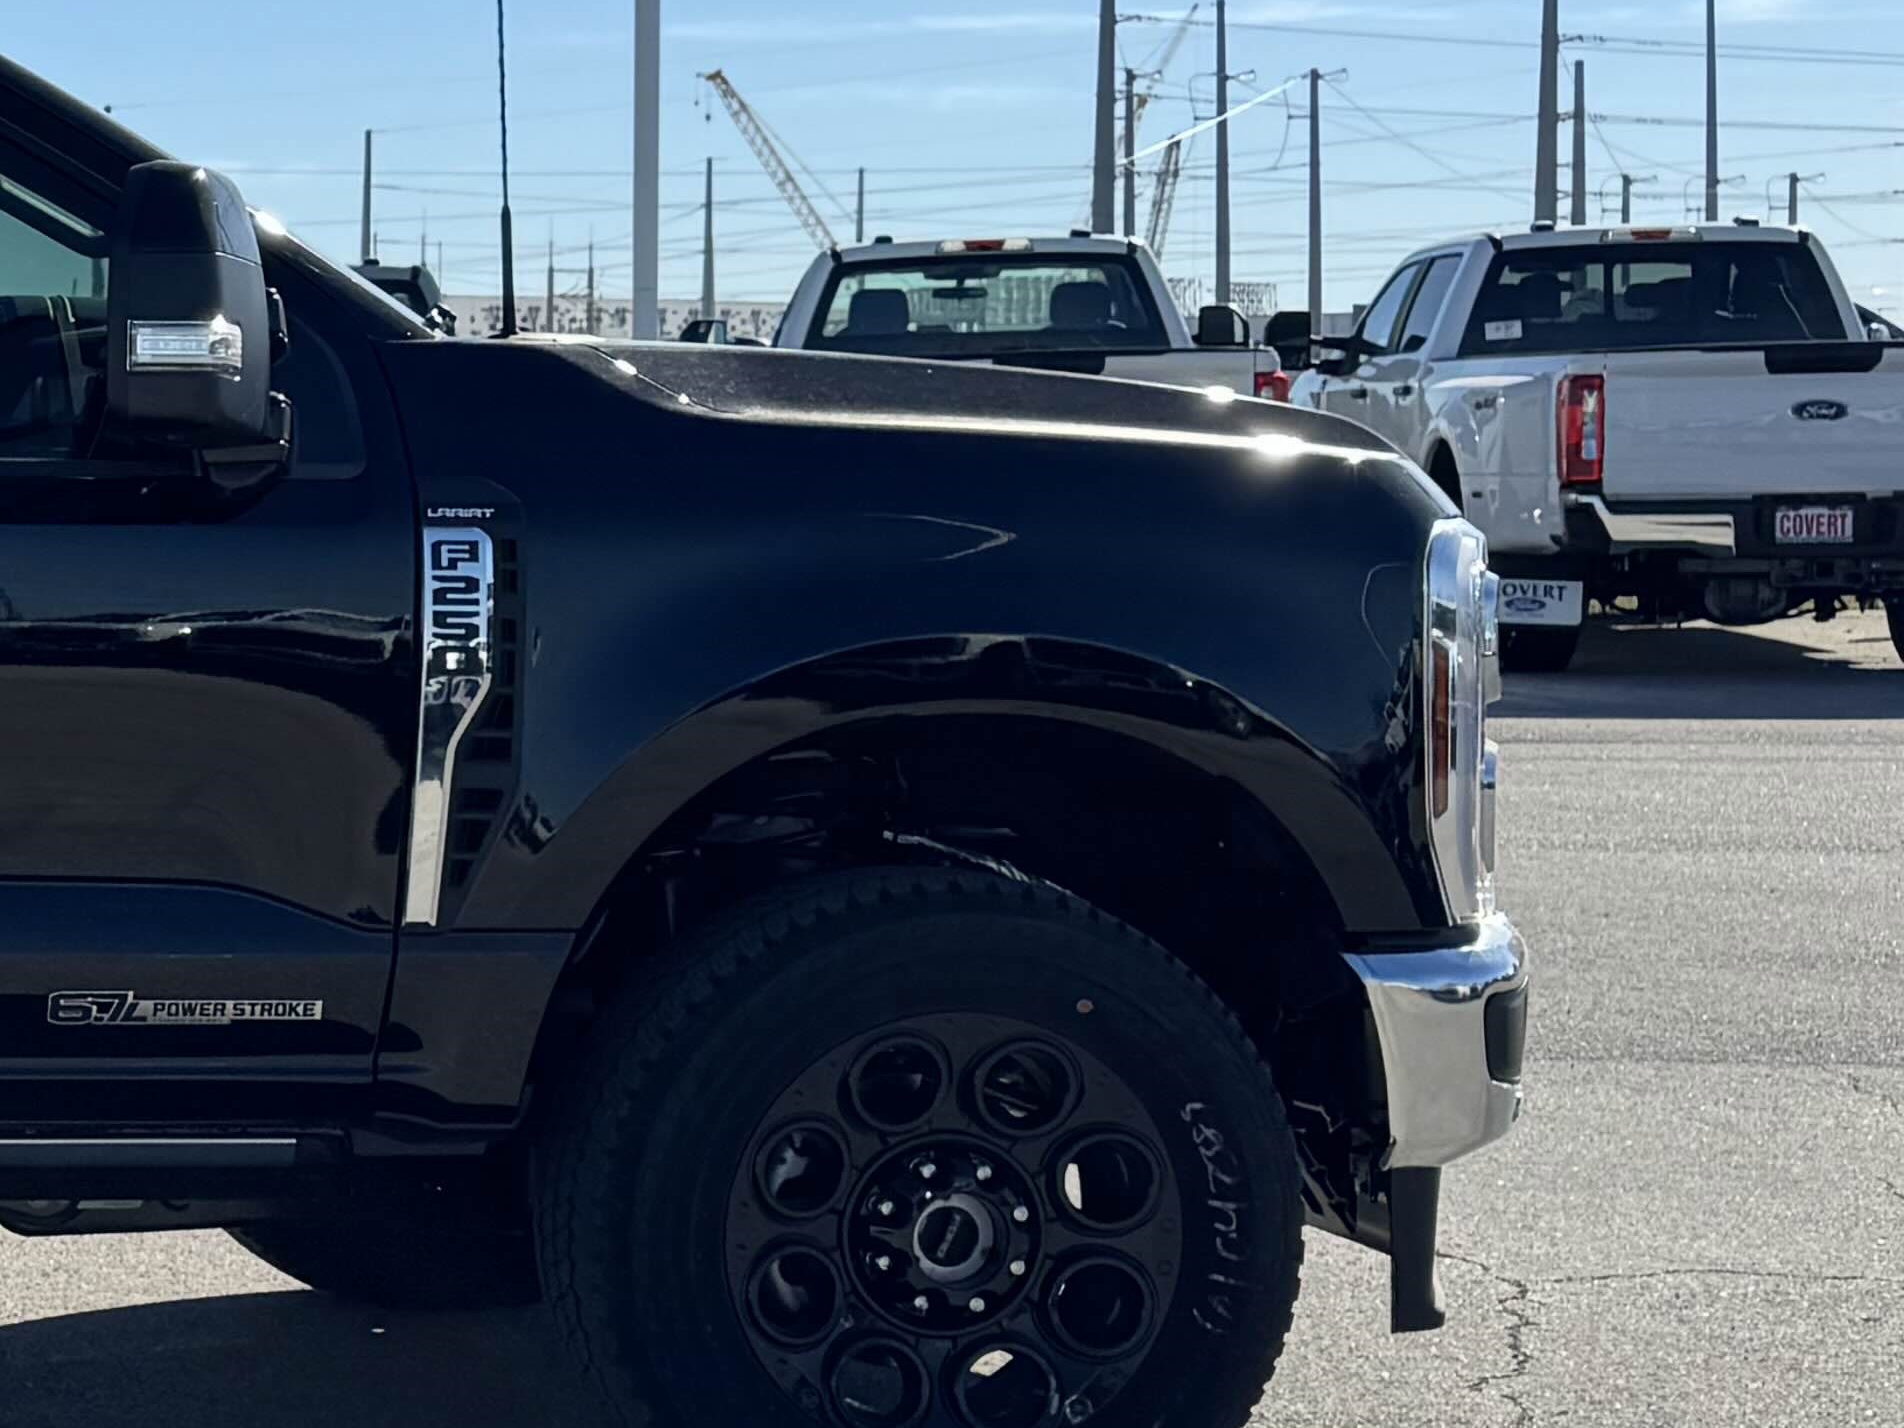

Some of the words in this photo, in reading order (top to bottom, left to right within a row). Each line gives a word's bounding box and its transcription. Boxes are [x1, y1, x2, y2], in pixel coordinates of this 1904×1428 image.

[427, 507, 495, 518] LARIAT
[1780, 513, 1848, 538] COVERT
[1501, 583, 1568, 603] OVERT
[153, 1001, 226, 1018] POWER
[232, 1001, 316, 1018] STROKE
